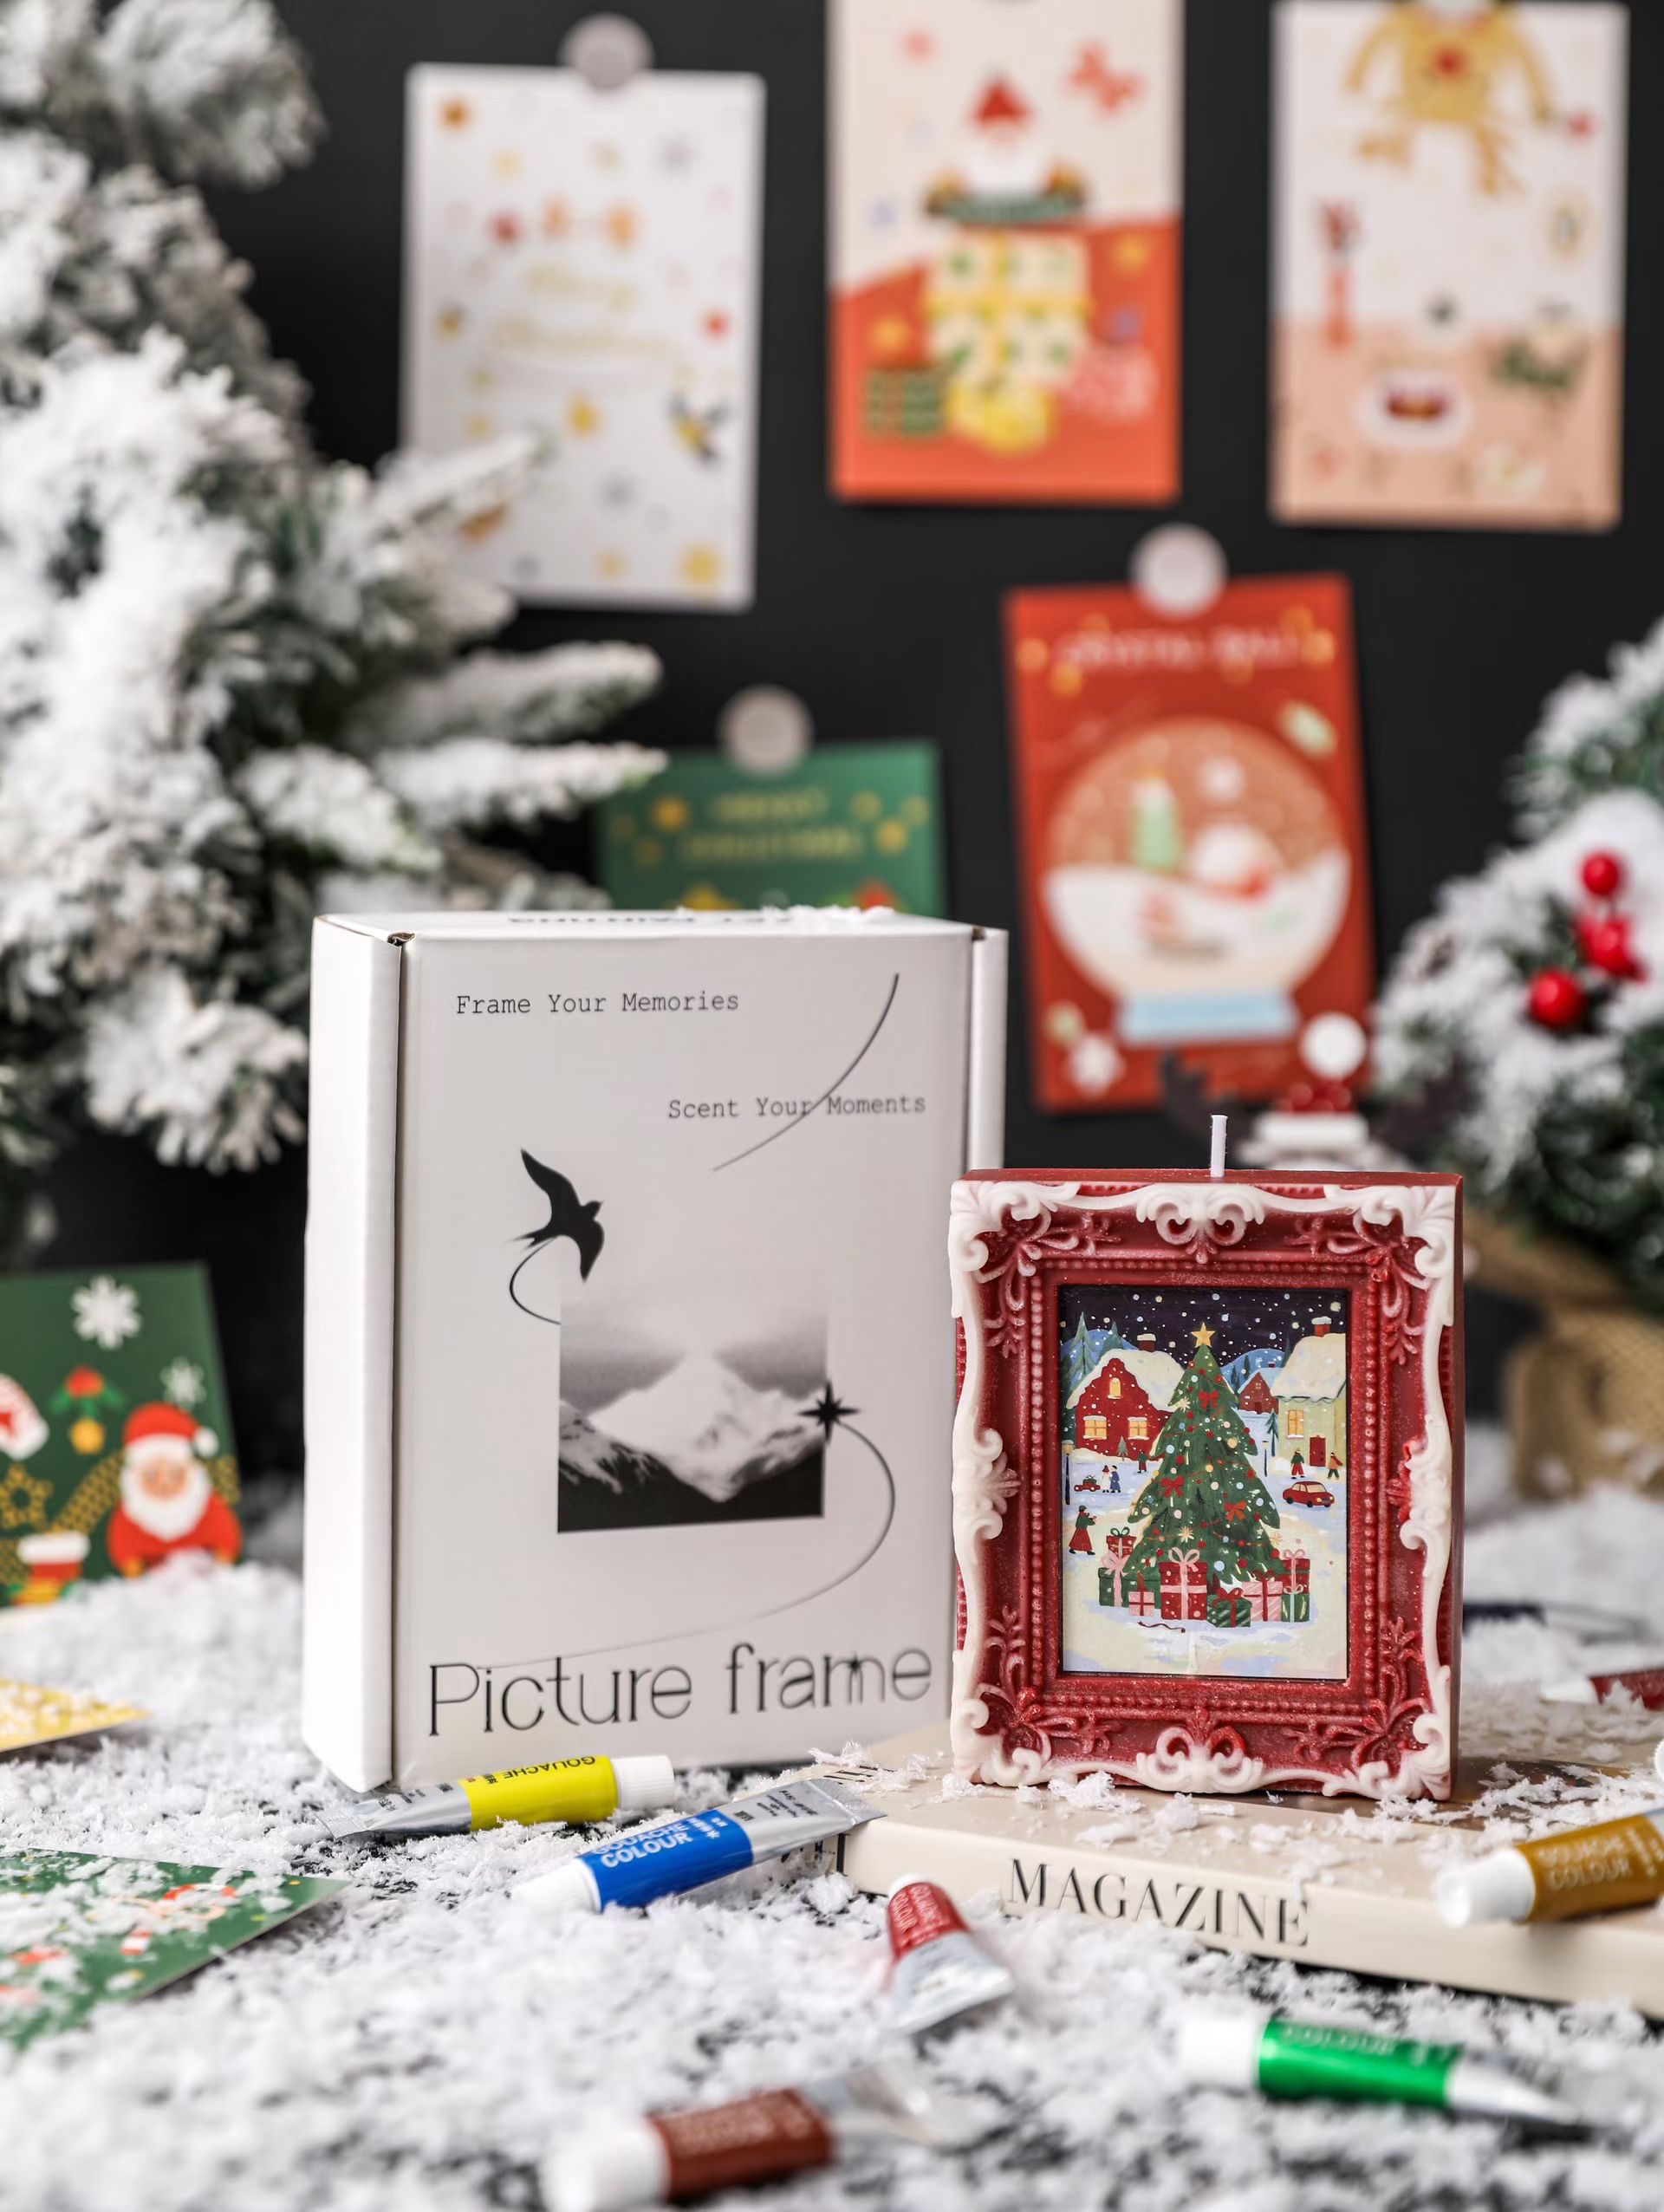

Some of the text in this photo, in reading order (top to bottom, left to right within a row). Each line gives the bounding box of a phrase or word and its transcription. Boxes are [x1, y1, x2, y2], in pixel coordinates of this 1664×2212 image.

[456, 990, 740, 1015] Frame Your Memories
[667, 1094, 926, 1120] Scent Your Moments
[428, 1643, 933, 1737] Picture frame
[503, 1756, 596, 1779] GOUACHE
[600, 1831, 693, 1869] COLOUR
[1007, 1857, 1310, 1949] MAGAZINE
